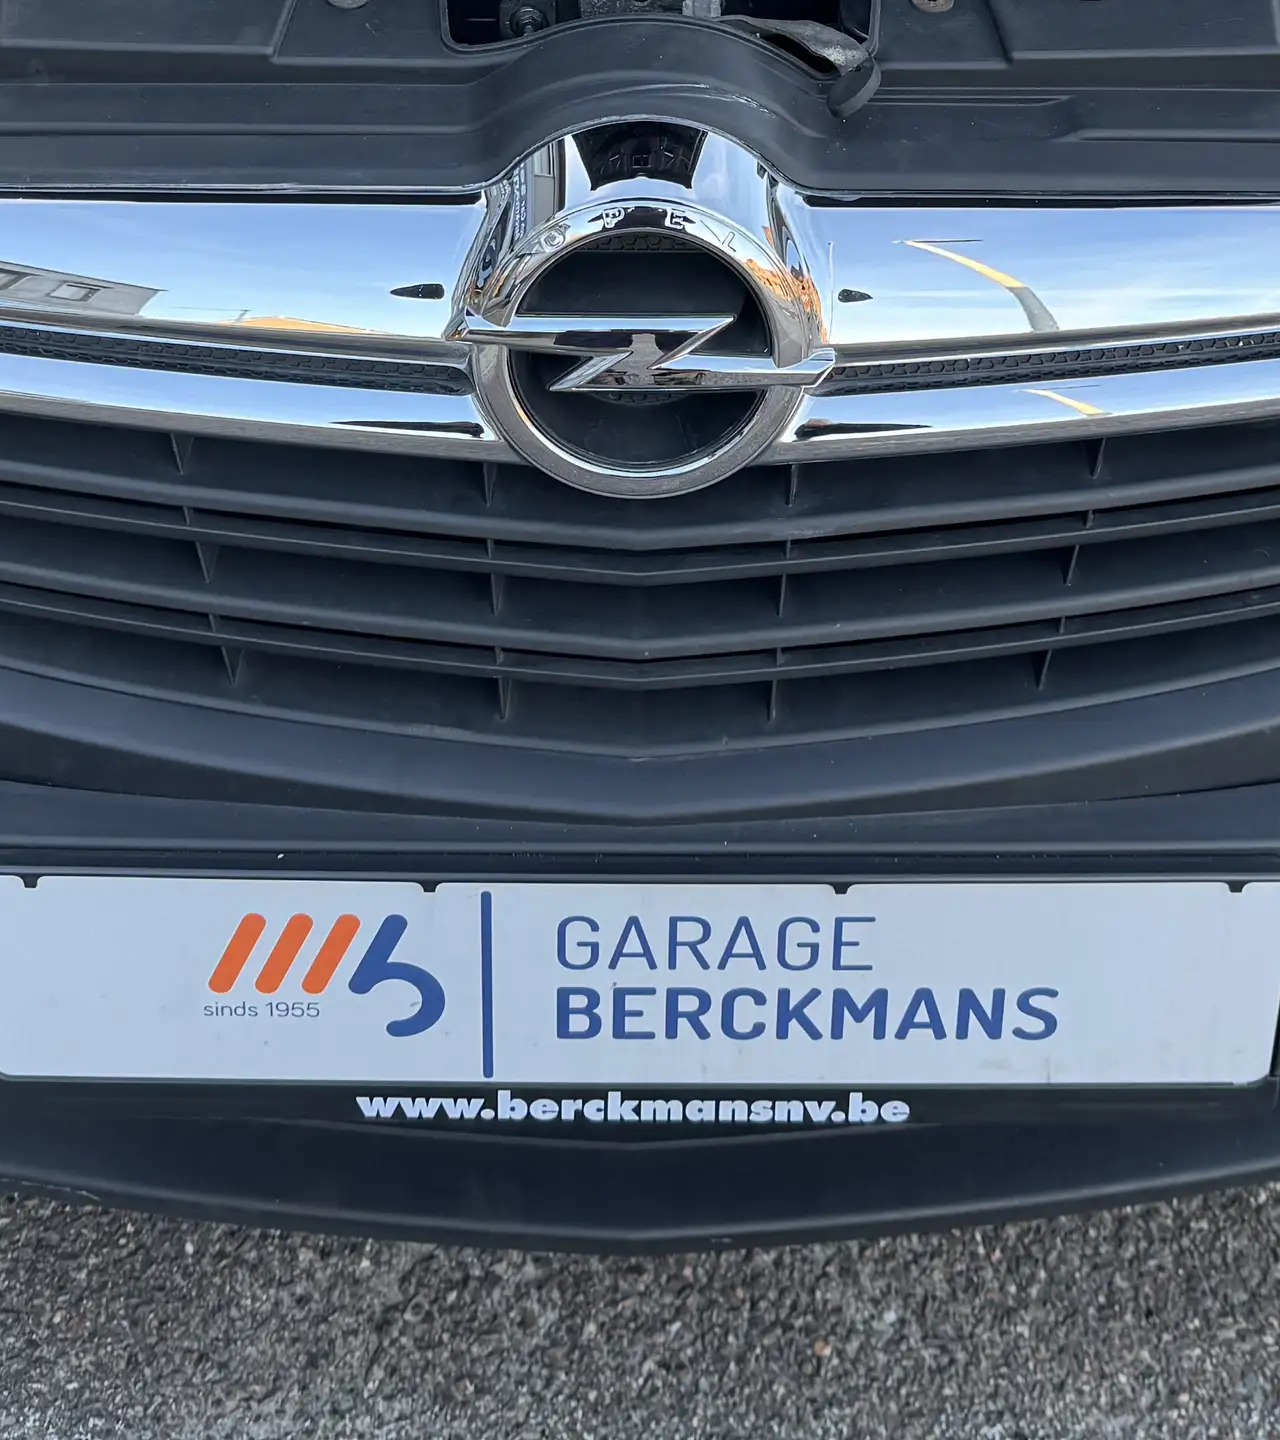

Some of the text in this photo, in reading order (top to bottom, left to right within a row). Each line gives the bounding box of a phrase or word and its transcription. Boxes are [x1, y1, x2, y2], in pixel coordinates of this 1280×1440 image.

[557, 915, 877, 971] GARAGE
[203, 1001, 320, 1017] sinds 1955
[557, 987, 1059, 1040] BERCKMANS
[355, 1089, 910, 1123] www.berckmansnv.be
